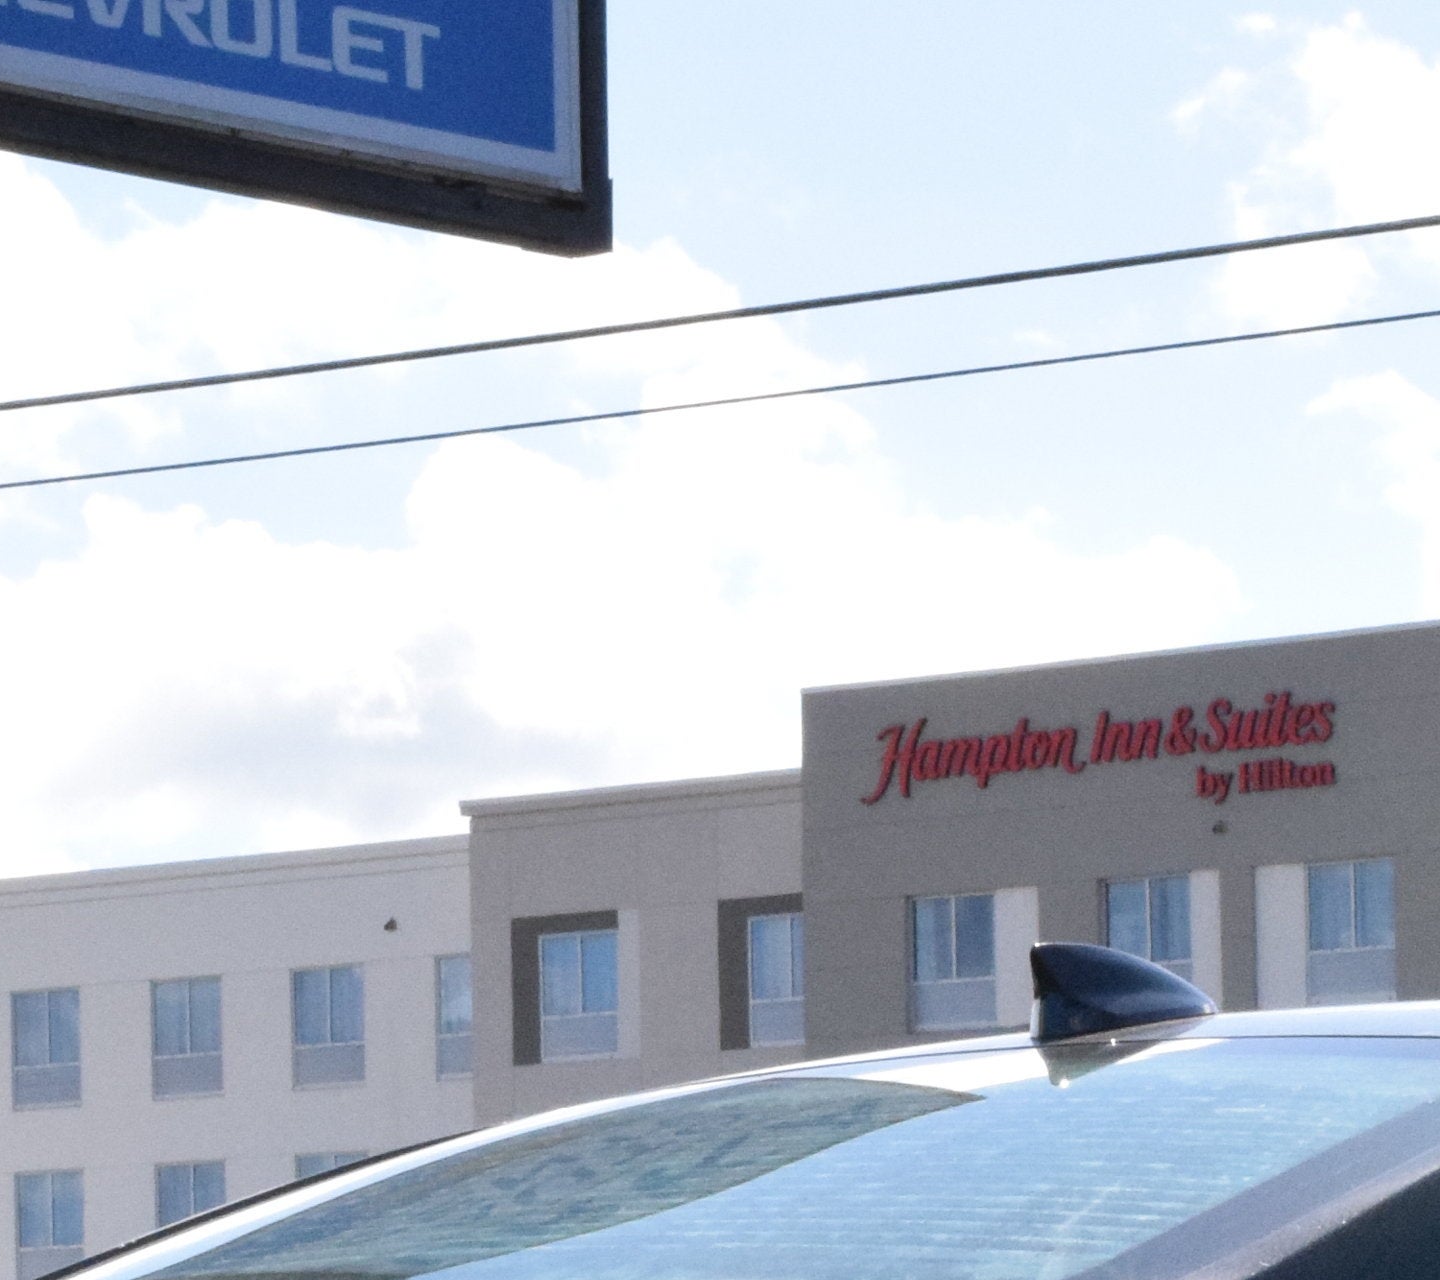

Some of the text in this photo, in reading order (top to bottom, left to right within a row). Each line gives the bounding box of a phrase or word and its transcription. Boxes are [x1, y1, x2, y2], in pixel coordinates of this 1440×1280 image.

[861, 692, 1335, 805] Hampton Inn & Suites
[1196, 757, 1336, 804] by Hilton
